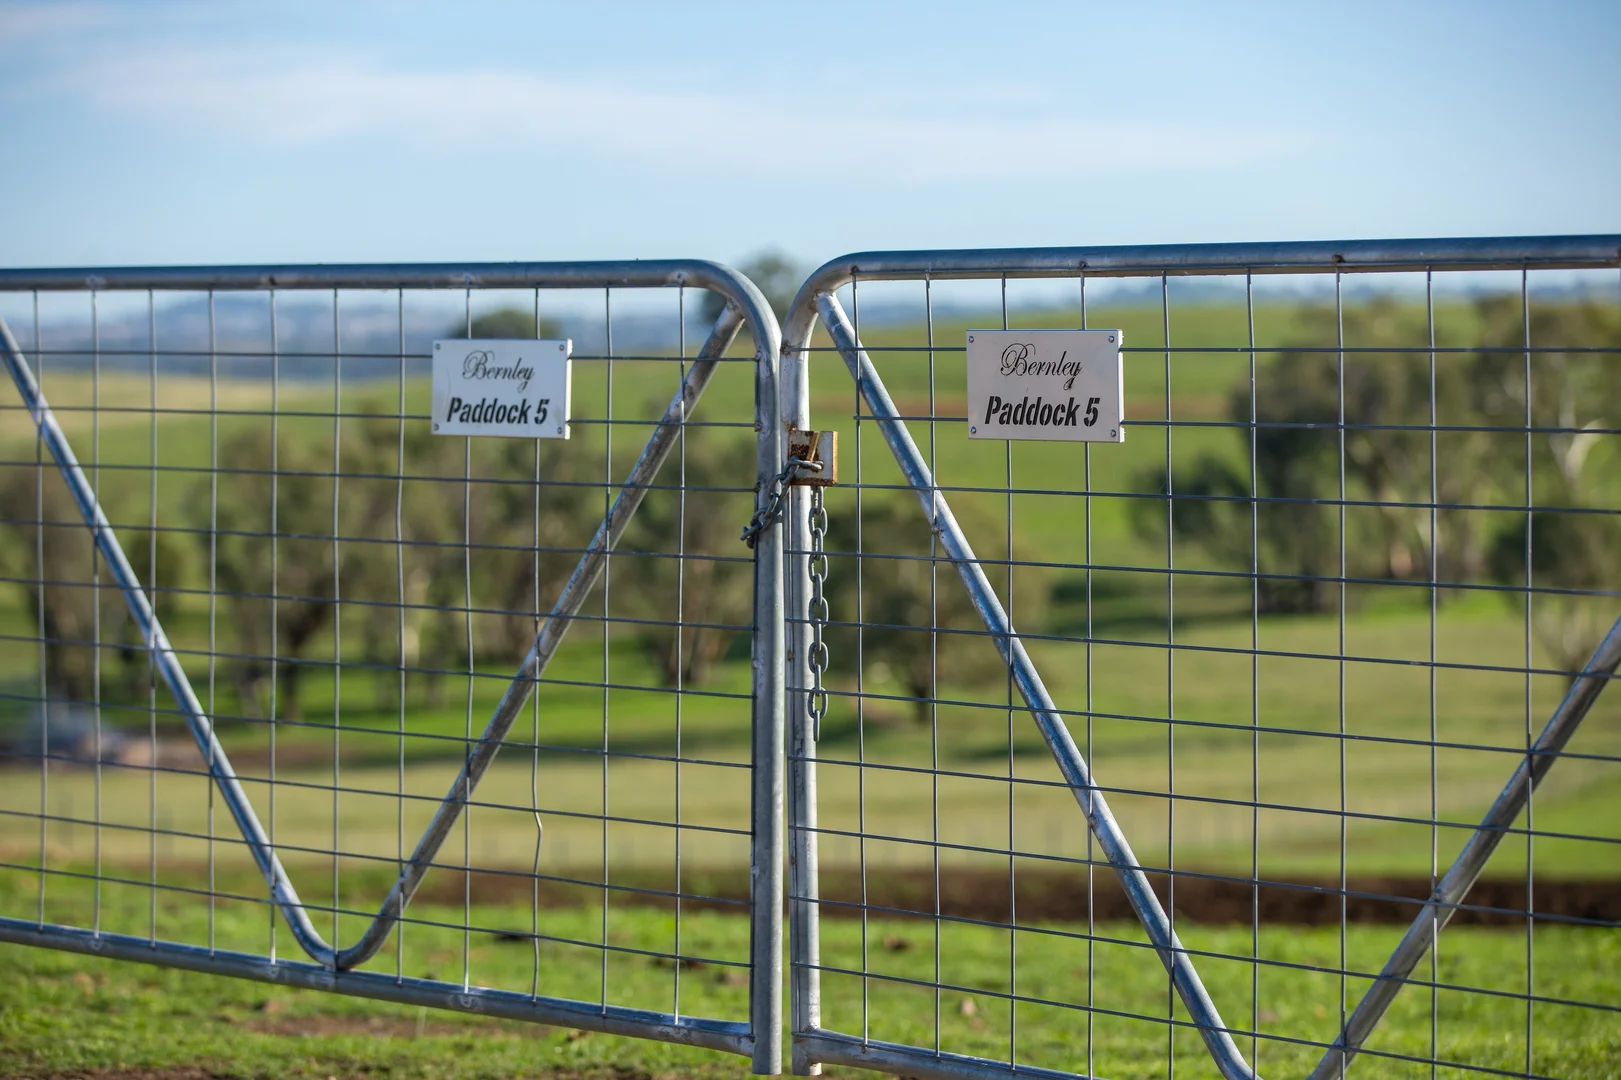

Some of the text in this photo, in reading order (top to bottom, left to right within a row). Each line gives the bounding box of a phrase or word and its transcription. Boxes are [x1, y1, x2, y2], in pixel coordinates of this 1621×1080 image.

[462, 350, 534, 393] Bernley
[1001, 343, 1082, 391] Bernley
[446, 397, 550, 424] Paddock 5
[984, 396, 1100, 427] Paddock 5
